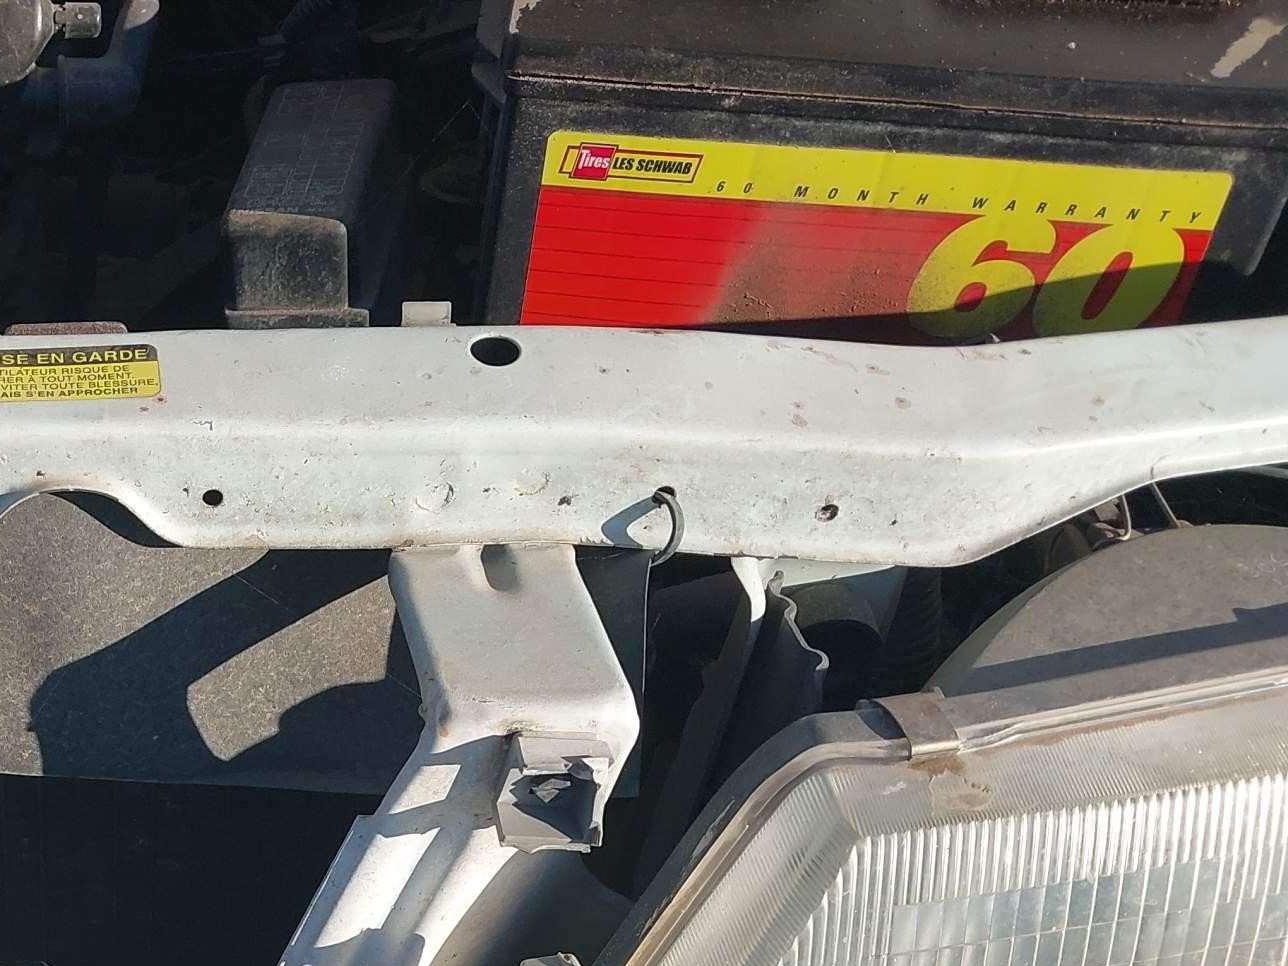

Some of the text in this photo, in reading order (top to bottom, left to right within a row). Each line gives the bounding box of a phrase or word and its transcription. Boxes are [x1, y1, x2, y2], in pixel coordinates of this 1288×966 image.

[576, 149, 693, 175] Tires LES SCHWAB
[715, 180, 1202, 224] 60 MONTH WARRANTY
[906, 211, 1185, 339] 60
[36, 352, 68, 365] EN
[72, 349, 148, 363] GARDE
[61, 366, 105, 375] RISQUE
[113, 365, 130, 373] DE
[38, 374, 75, 383] TOUT
[77, 372, 135, 381] MOMENT.
[25, 389, 54, 398] S'EN
[55, 386, 138, 397] APPROCHER
[43, 381, 86, 390] TOUTE
